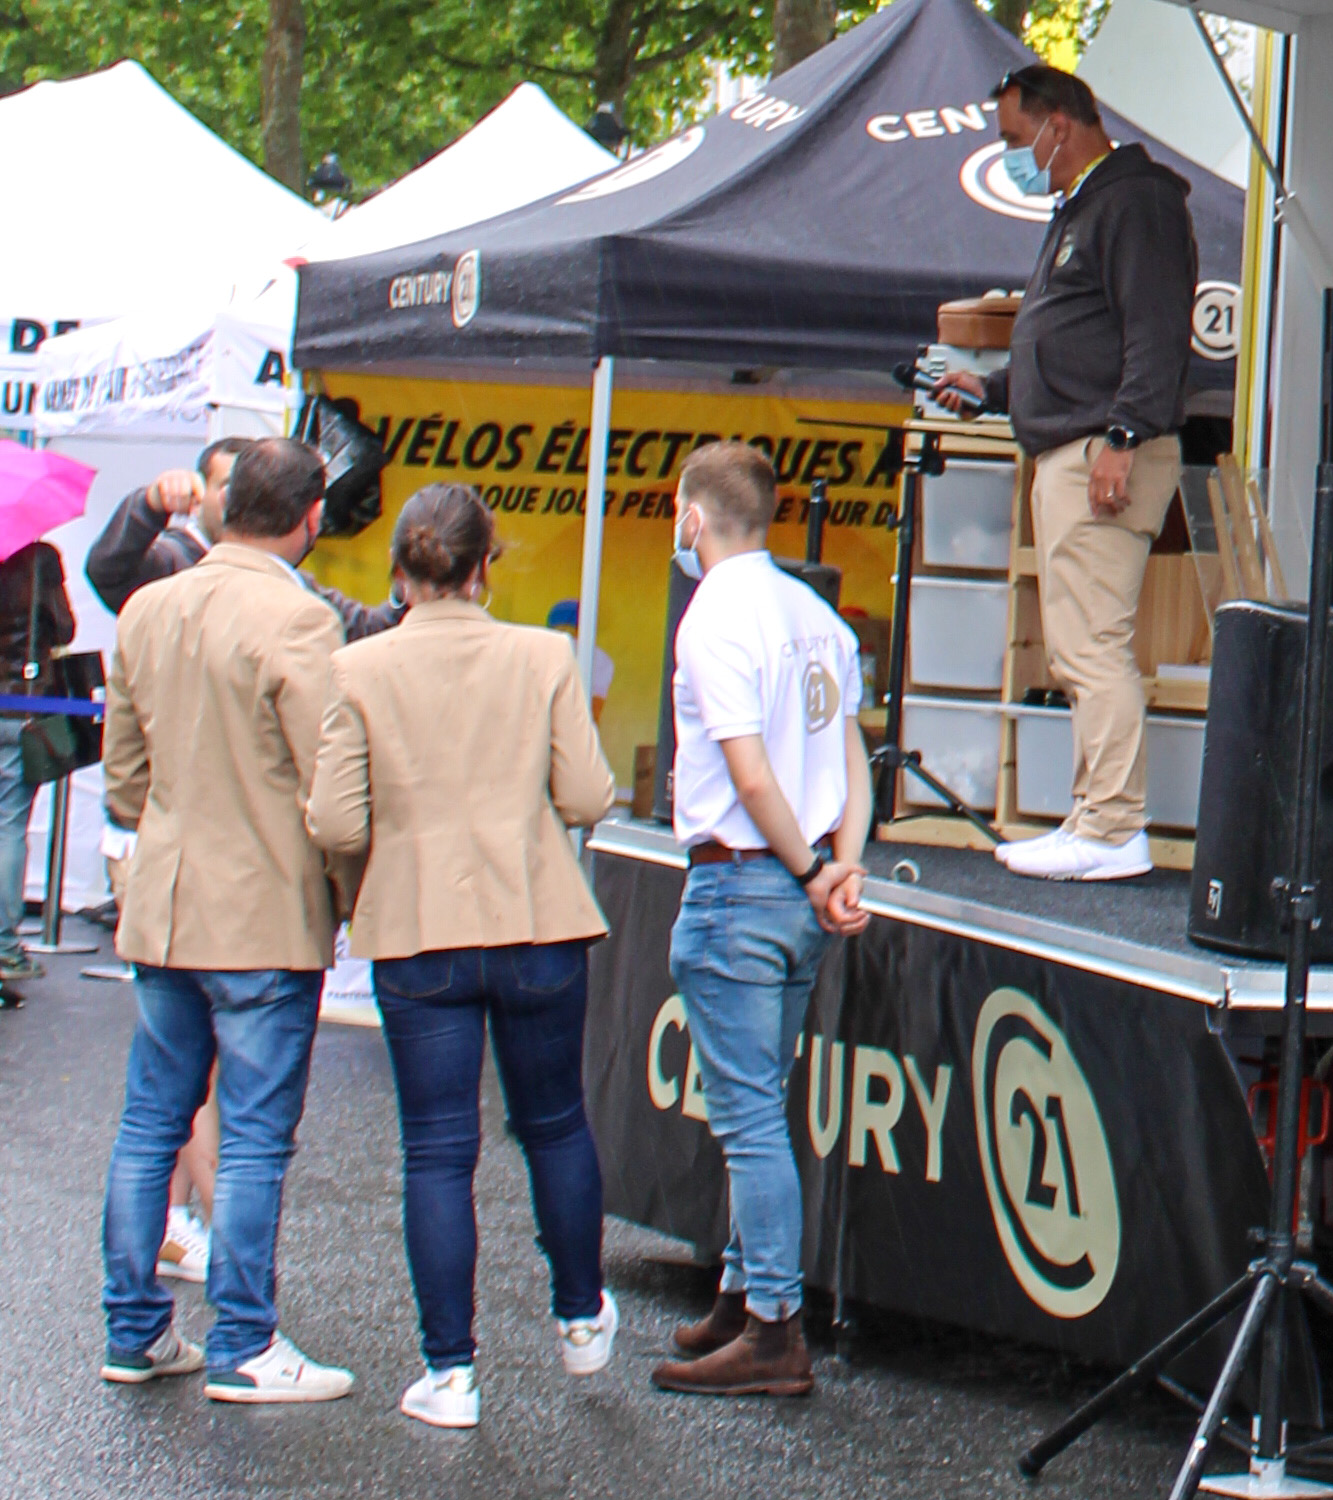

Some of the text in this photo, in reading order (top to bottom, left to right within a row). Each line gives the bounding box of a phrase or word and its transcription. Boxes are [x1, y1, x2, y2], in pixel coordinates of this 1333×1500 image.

[389, 270, 452, 310] CENTURY
[1203, 304, 1234, 335] 21
[373, 411, 534, 471] VÉLOS
[534, 418, 863, 487] ÉLECTUES
[647, 993, 1082, 1221] CURY 21
